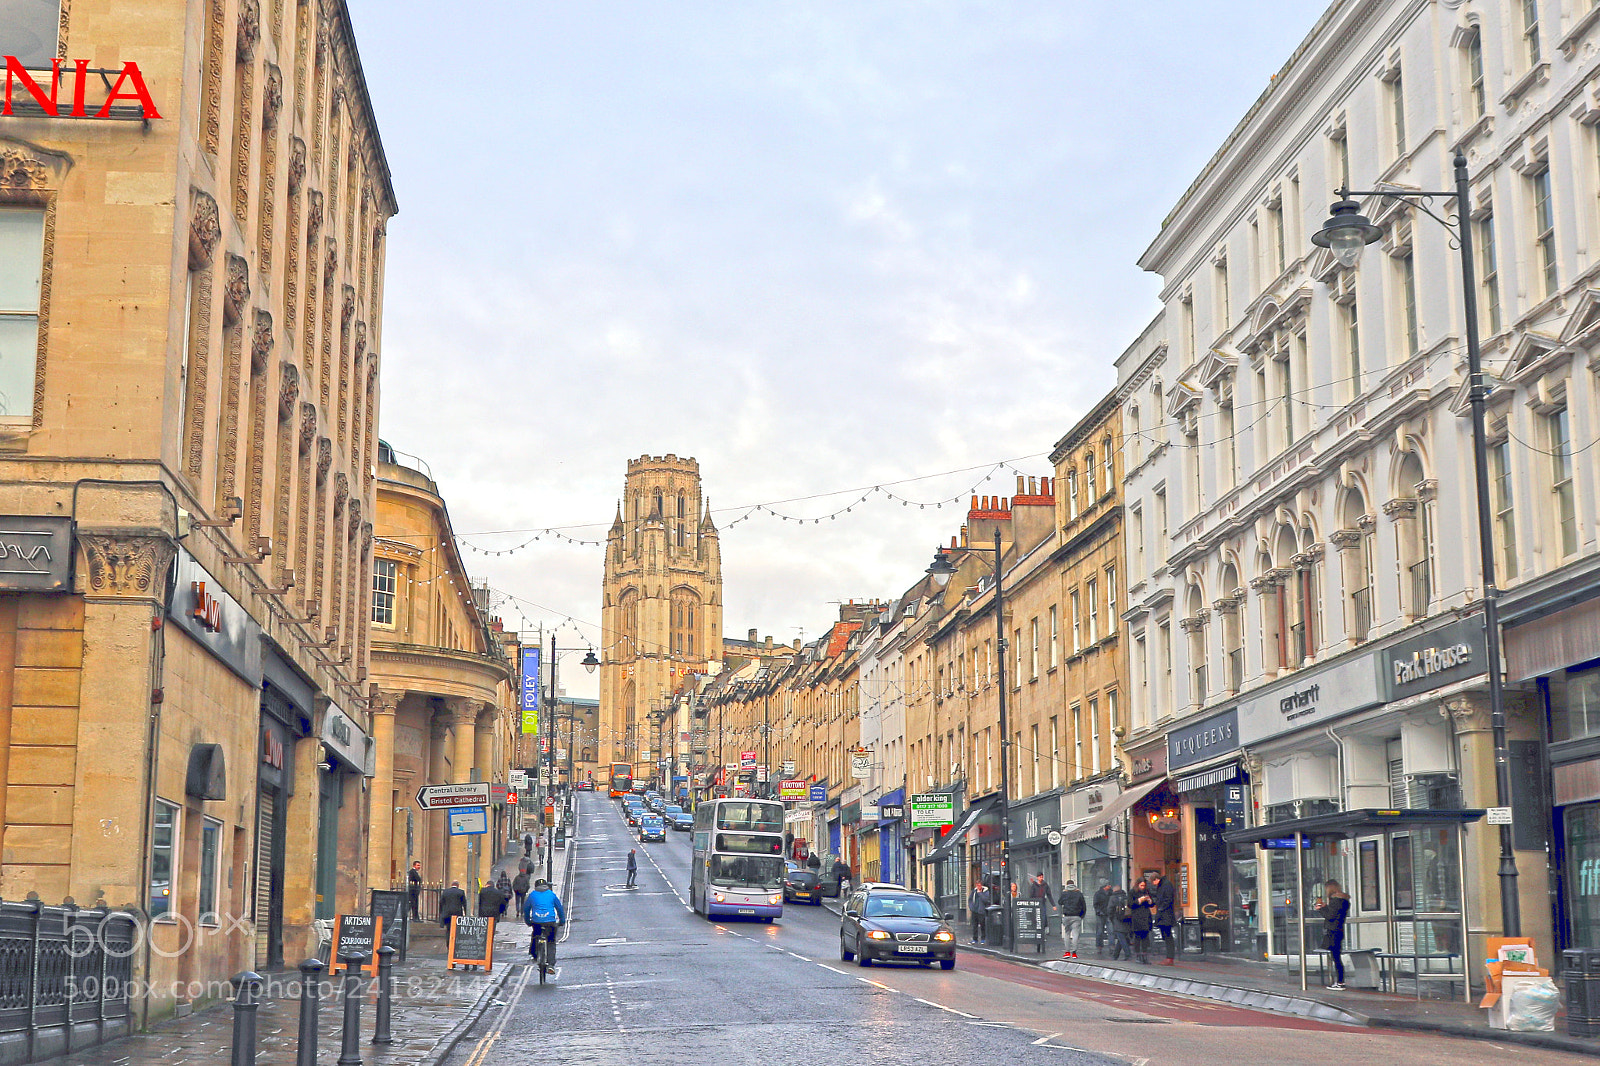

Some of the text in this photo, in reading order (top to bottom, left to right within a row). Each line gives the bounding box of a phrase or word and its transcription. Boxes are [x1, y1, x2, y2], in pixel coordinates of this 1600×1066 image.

[1, 55, 163, 120] NIA
[1394, 649, 1424, 685] Park
[525, 674, 536, 708] FOLEY
[1280, 683, 1320, 714] carhartt
[429, 786, 477, 794] Central Library
[454, 795, 486, 803] Cathedral
[916, 794, 948, 802] alder king
[344, 916, 371, 926] ARTISAN
[456, 916, 488, 927] CHRISTMAS
[460, 926, 467, 935] IN
[340, 936, 372, 945] SOURDOUGH
